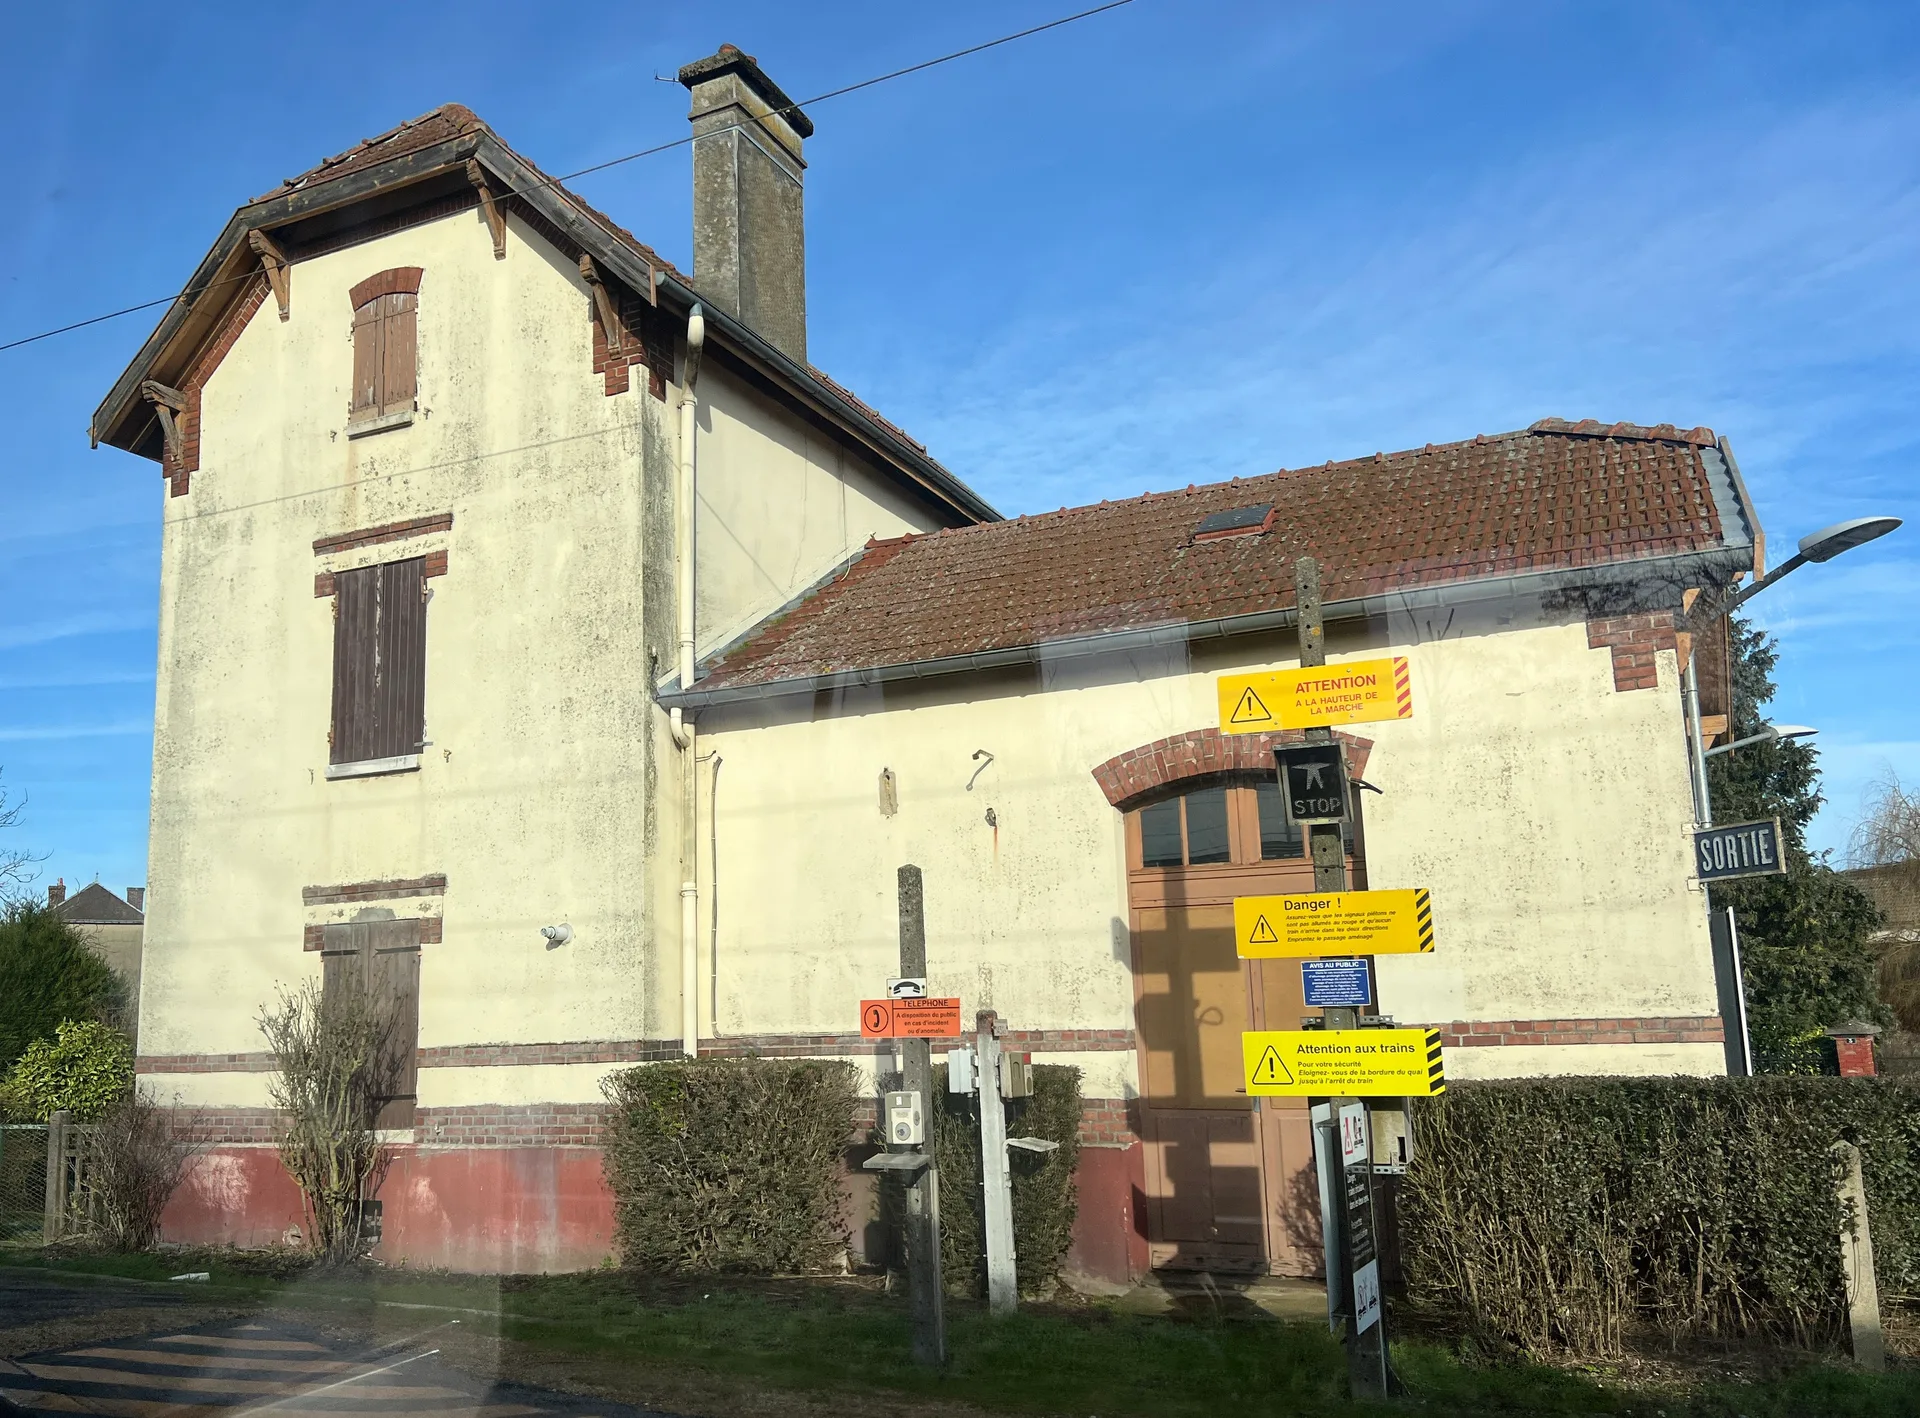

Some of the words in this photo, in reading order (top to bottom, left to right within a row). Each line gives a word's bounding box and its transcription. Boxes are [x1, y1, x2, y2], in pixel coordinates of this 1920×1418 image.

[1296, 675, 1376, 693] ATTENTION
[1320, 694, 1361, 704] HAUTEUR
[1326, 703, 1363, 713] MARCHE
[1294, 797, 1341, 814] STOP
[1700, 829, 1773, 871] SORTIE
[1284, 900, 1331, 911] Danger
[1337, 898, 1341, 908] !
[1297, 1044, 1351, 1054] Attention
[1380, 1043, 1415, 1053] trains
